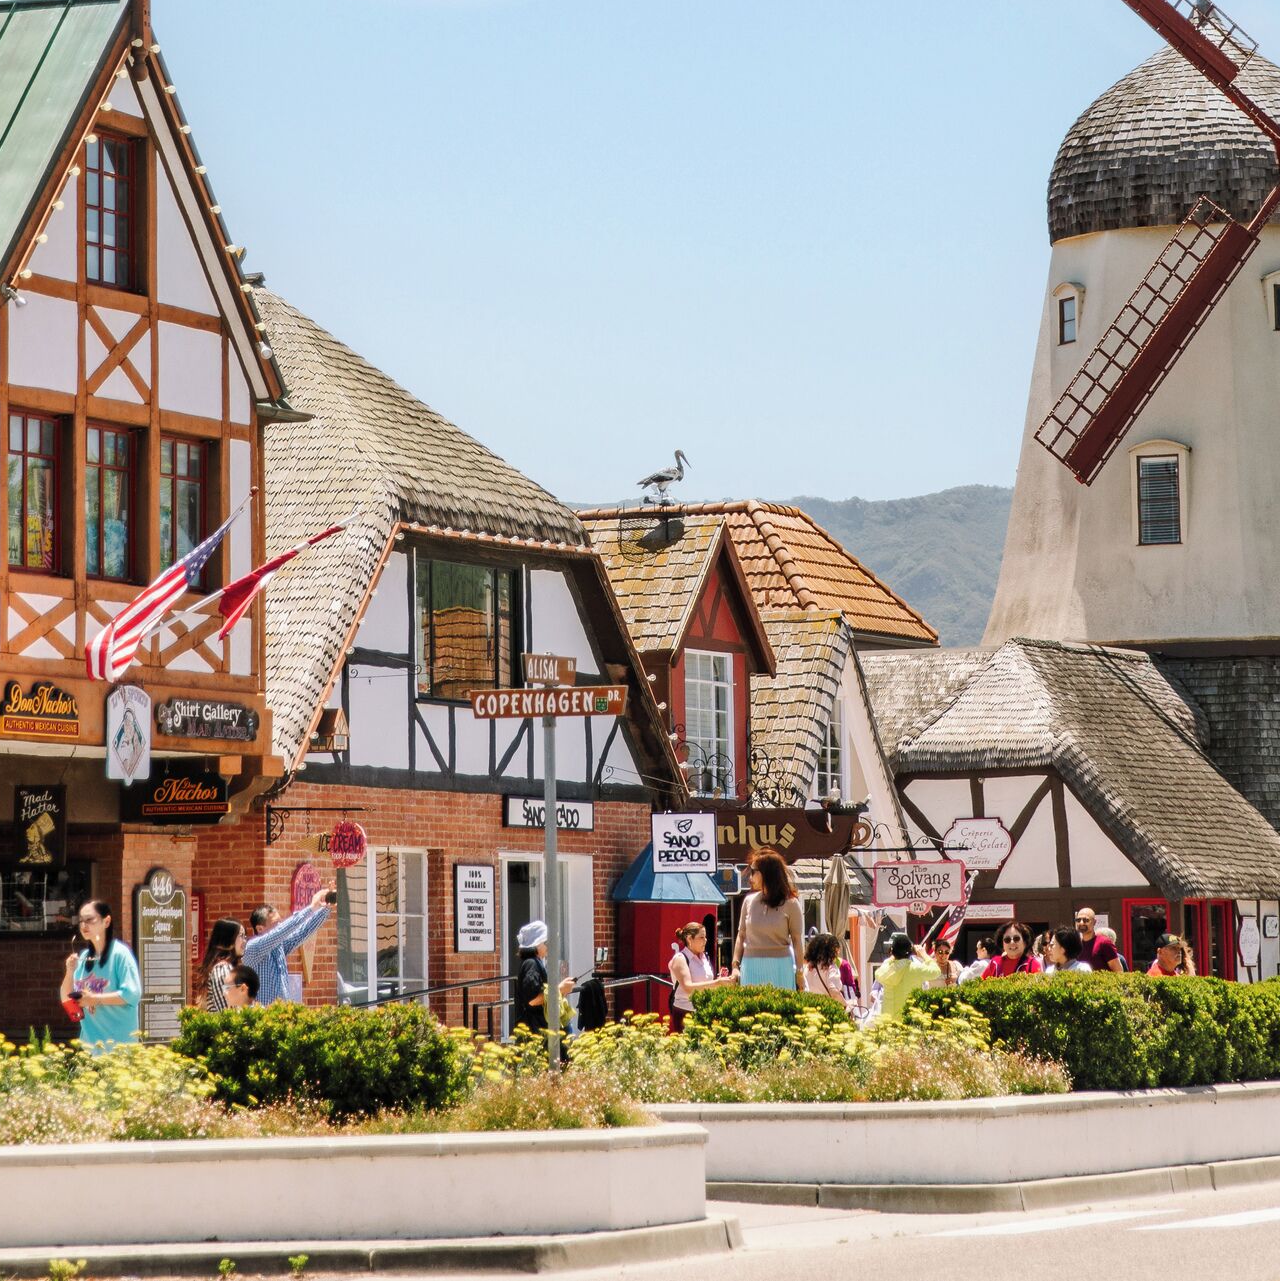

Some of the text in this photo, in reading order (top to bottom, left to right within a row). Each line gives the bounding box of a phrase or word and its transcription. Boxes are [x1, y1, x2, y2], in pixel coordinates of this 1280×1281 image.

[527, 658, 560, 680] ALISAL
[6, 684, 75, 715] Don Nacho's
[475, 689, 622, 716] COPENHAGEN DR.
[173, 701, 242, 728] Shirt Gallery
[5, 720, 77, 733] AUTHENTIC MEXICAN CUISINE
[23, 790, 53, 808] Mad
[154, 777, 218, 803] Nacho's
[20, 802, 60, 822] Hatter
[556, 804, 580, 828] CADO
[318, 832, 363, 854] ICE CREAM
[663, 831, 701, 848] SANO
[658, 847, 711, 862] PECADO
[469, 870, 482, 878] 100%
[888, 869, 951, 889] Solvang
[151, 876, 172, 897] 446
[464, 881, 487, 889] ORGANIC
[896, 885, 943, 901] Bakery
